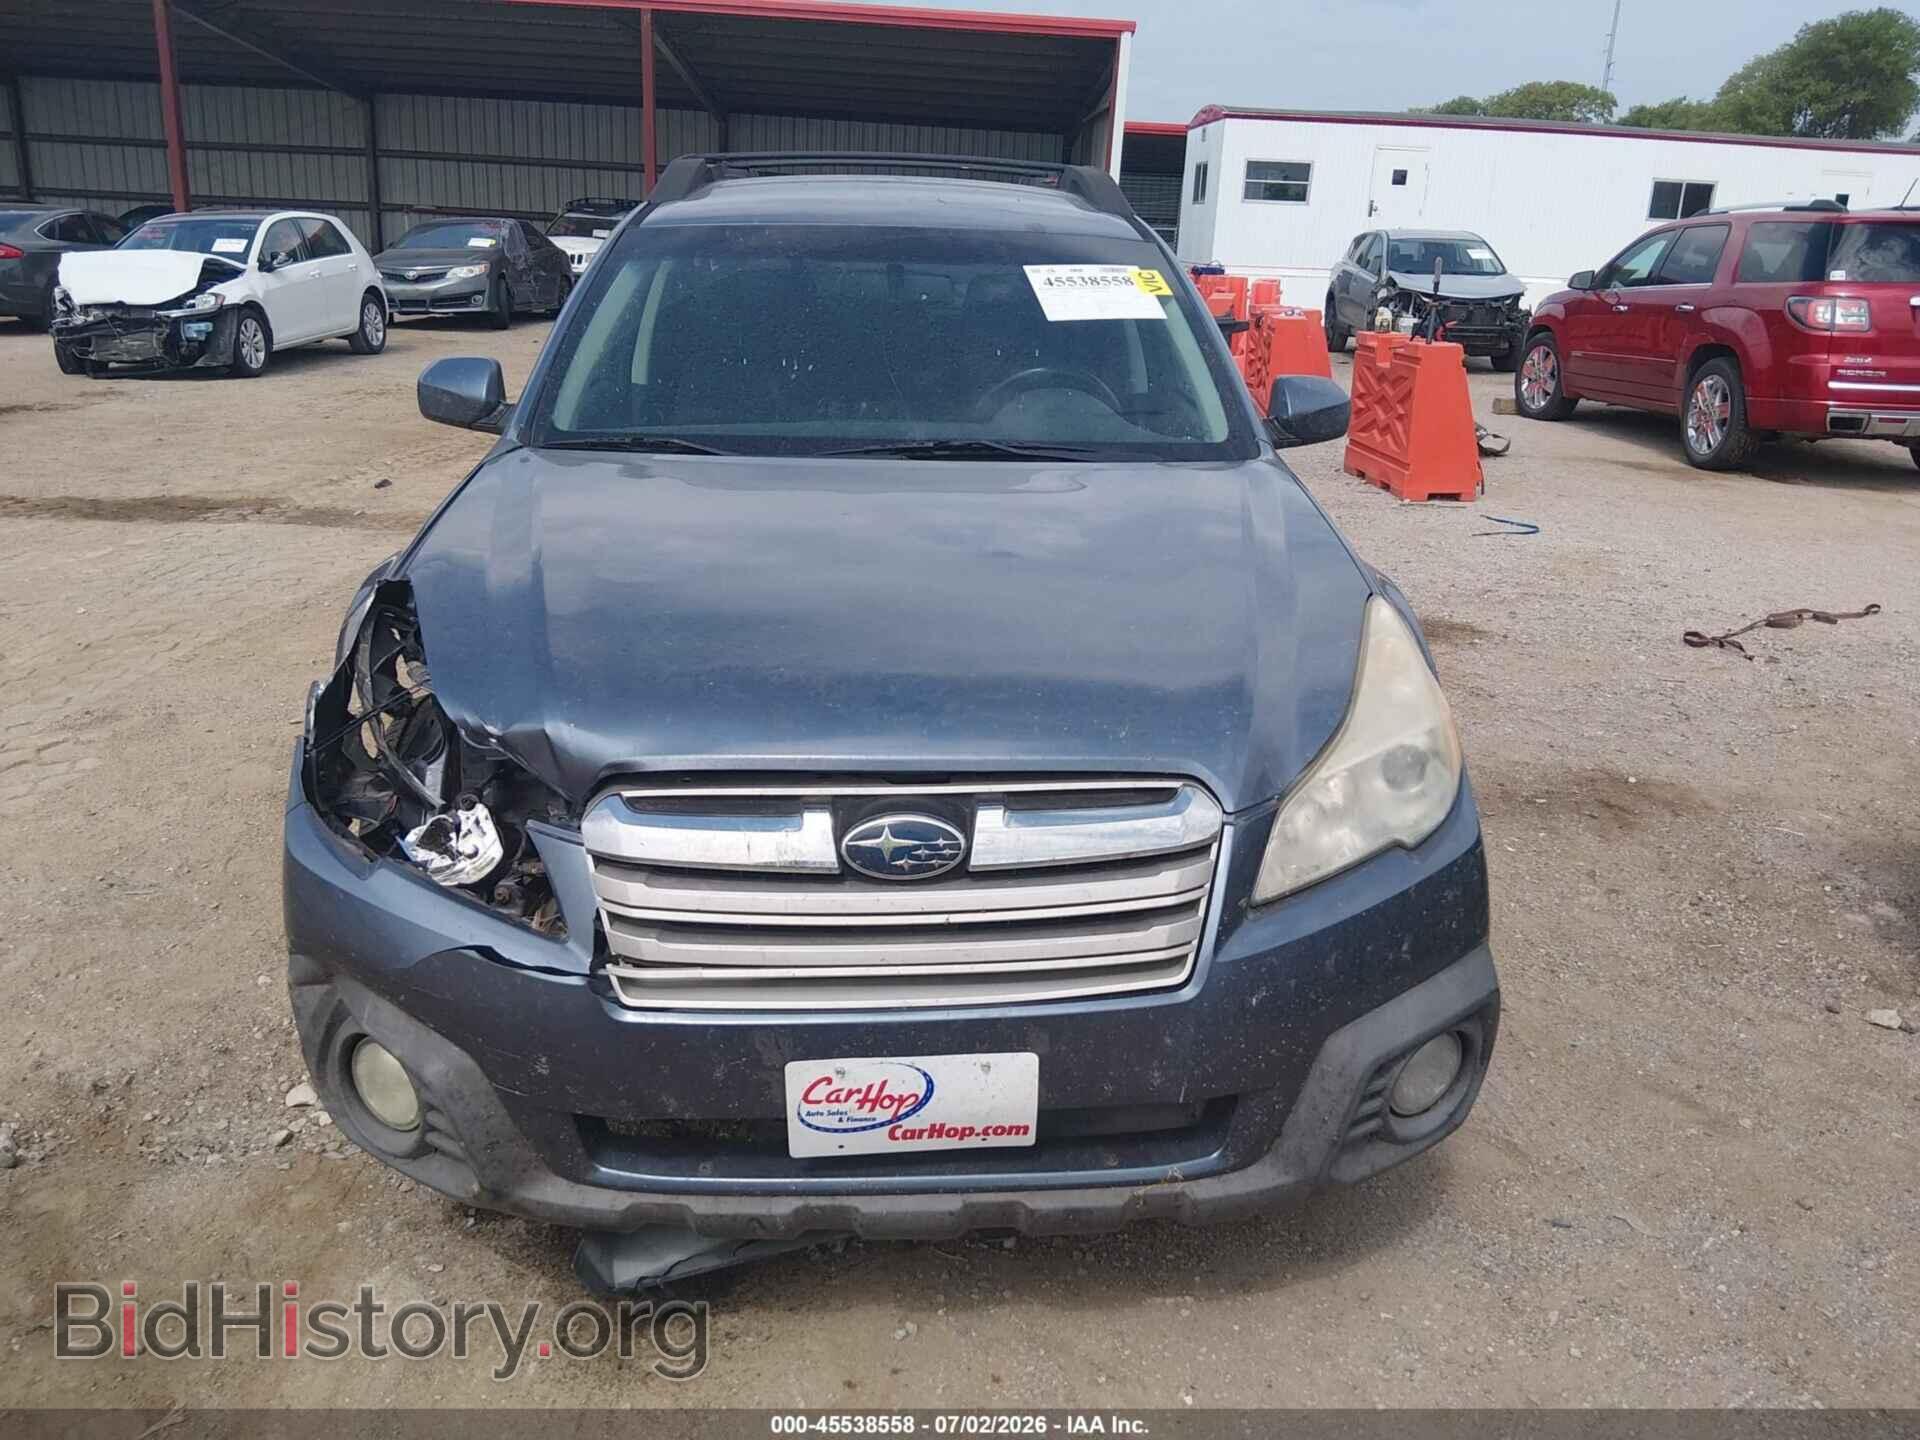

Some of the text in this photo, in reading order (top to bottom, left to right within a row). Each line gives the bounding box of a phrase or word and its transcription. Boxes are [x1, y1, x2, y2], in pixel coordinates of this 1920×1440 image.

[1043, 275, 1135, 287] 45538558
[801, 1075, 920, 1120] CarHop
[805, 1109, 848, 1118] Auto Sales
[888, 1122, 1030, 1141] CarHop.com
